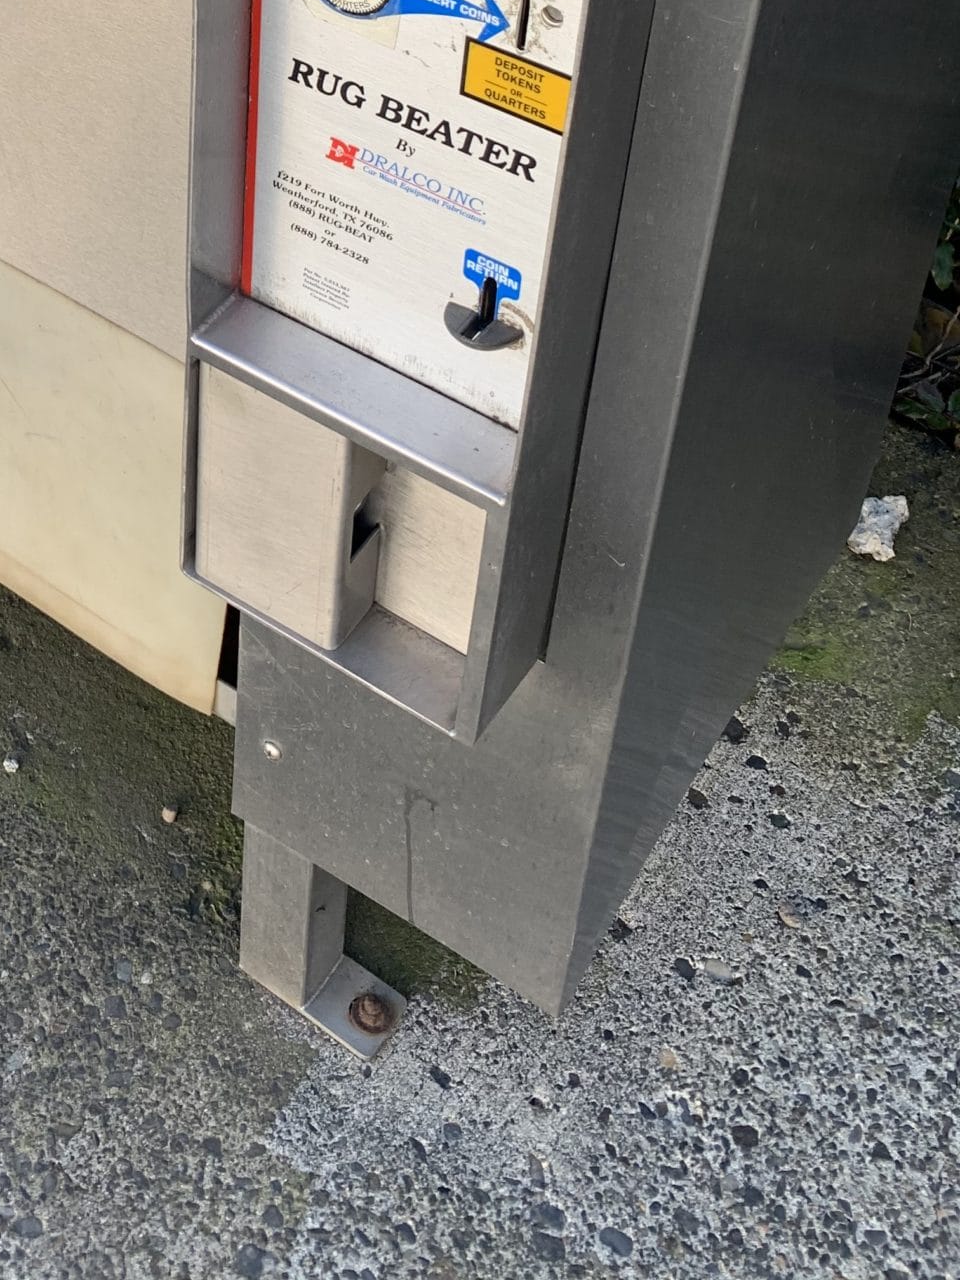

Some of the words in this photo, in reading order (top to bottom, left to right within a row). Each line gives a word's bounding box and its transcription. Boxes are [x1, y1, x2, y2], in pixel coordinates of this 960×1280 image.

[459, 5, 500, 27] COINS
[494, 56, 545, 83] DEPOSIT
[495, 68, 541, 94] TOKENS
[484, 88, 546, 120] QUARTERS
[510, 88, 523, 99] OR
[288, 58, 366, 109] RUG
[376, 93, 538, 183] BEATER
[396, 138, 416, 158] By
[361, 148, 442, 193] DRALCO
[447, 186, 487, 216] INC.
[363, 166, 376, 176] Car
[379, 173, 397, 186] Wash
[400, 182, 439, 205] Equipment
[442, 201, 487, 226] Fabricators
[273, 180, 338, 217] Weatherford,
[342, 211, 357, 224] TX
[359, 220, 393, 241] 76086
[277, 170, 302, 187] 1219
[304, 184, 325, 198] Fort
[329, 194, 360, 214] Worth
[364, 210, 390, 228] Hwy.
[289, 200, 316, 218] (888)
[319, 213, 375, 243] RUG-BEAT
[324, 229, 336, 237] or
[290, 223, 317, 241] (888)
[320, 236, 370, 264] 784-2328
[467, 259, 518, 290] RETURN
[477, 255, 509, 277] COIN
